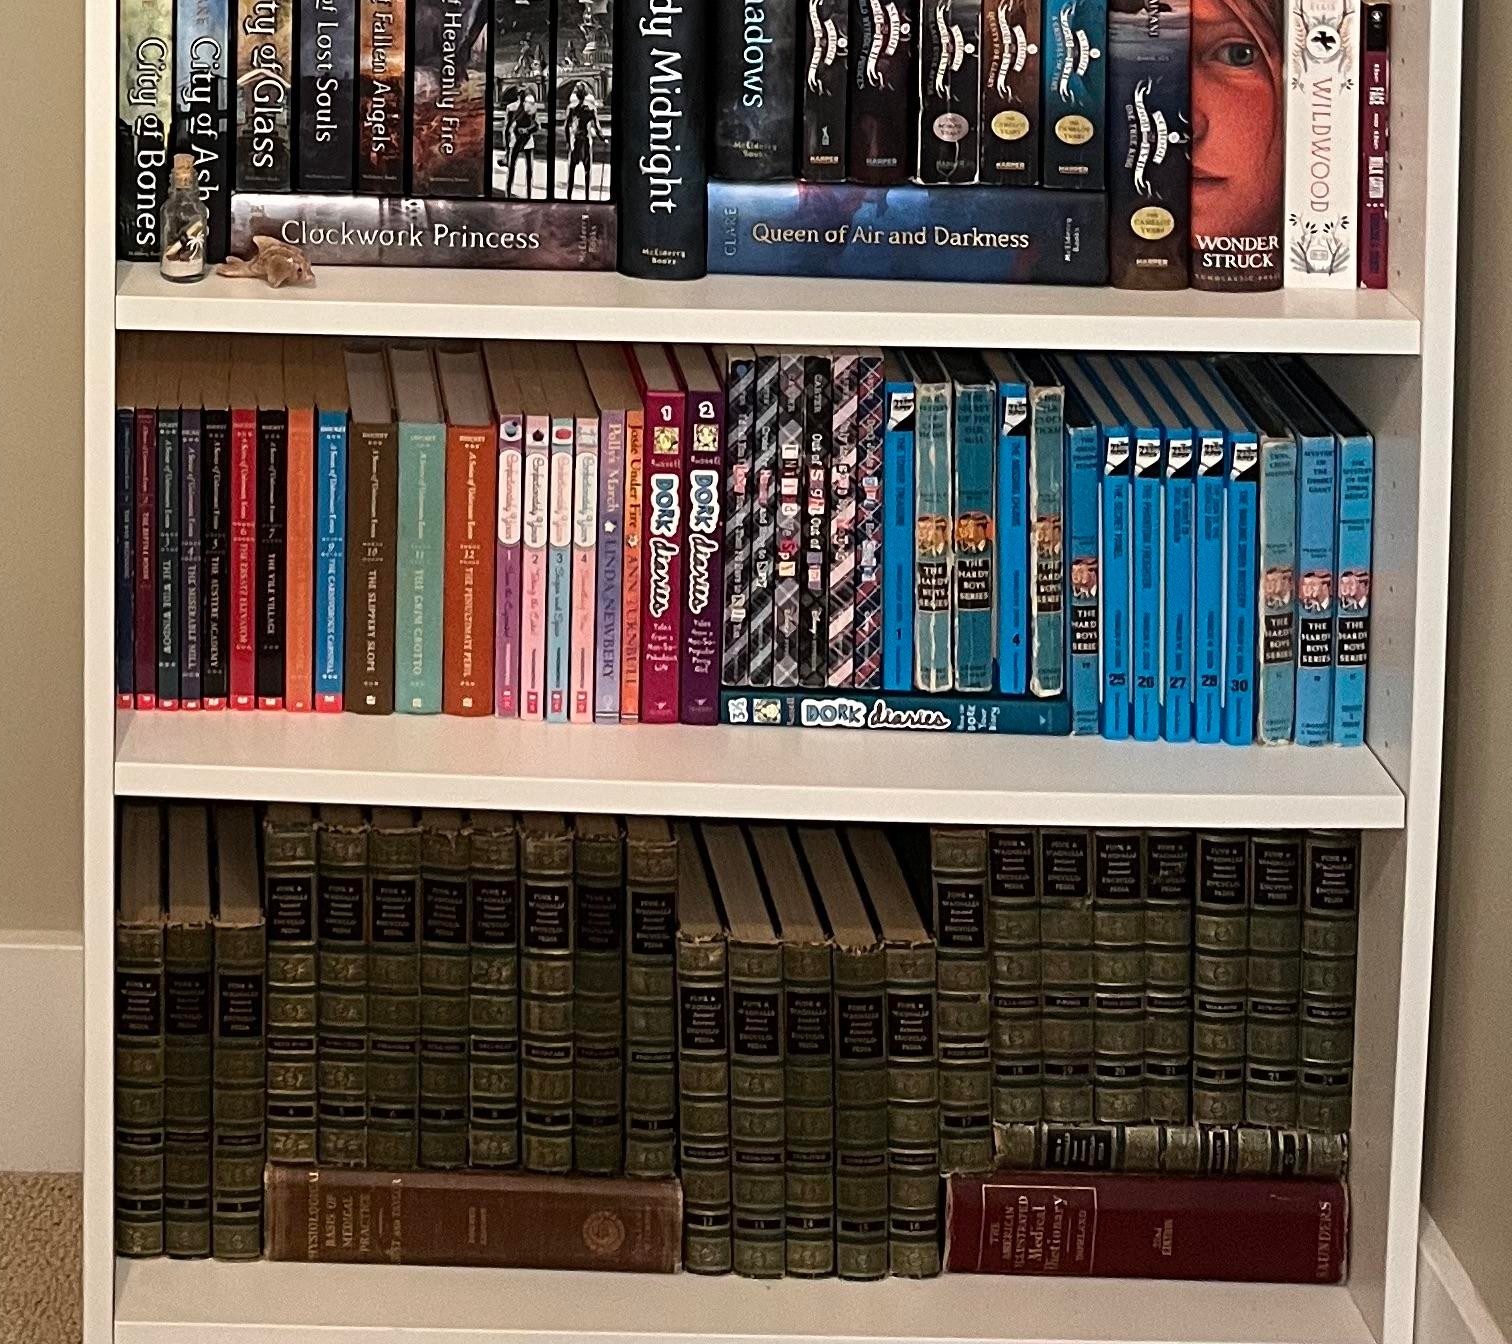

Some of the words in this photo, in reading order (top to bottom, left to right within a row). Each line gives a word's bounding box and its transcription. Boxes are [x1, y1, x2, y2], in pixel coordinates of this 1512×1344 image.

[251, 45, 277, 73] of
[252, 77, 283, 169] Glass
[639, 48, 683, 214] Midnight
[1310, 78, 1333, 213] WILDWOOD
[281, 220, 423, 247] Clockwork
[435, 223, 540, 249] Princess
[752, 224, 819, 243] Queen
[825, 225, 847, 243] of
[853, 227, 884, 244] Air
[889, 229, 926, 245] and
[934, 228, 1029, 248] Darkness
[1197, 235, 1279, 252] WONDER
[1202, 253, 1274, 268] STRUCK
[651, 475, 680, 536] DORK
[651, 538, 680, 616] diaries
[1109, 674, 1126, 685] 25
[1169, 675, 1186, 688] 27
[1231, 680, 1248, 692] 30
[802, 702, 866, 725] DORK
[869, 702, 950, 727] diaries
[1316, 1202, 1331, 1279] SAUNDERS
